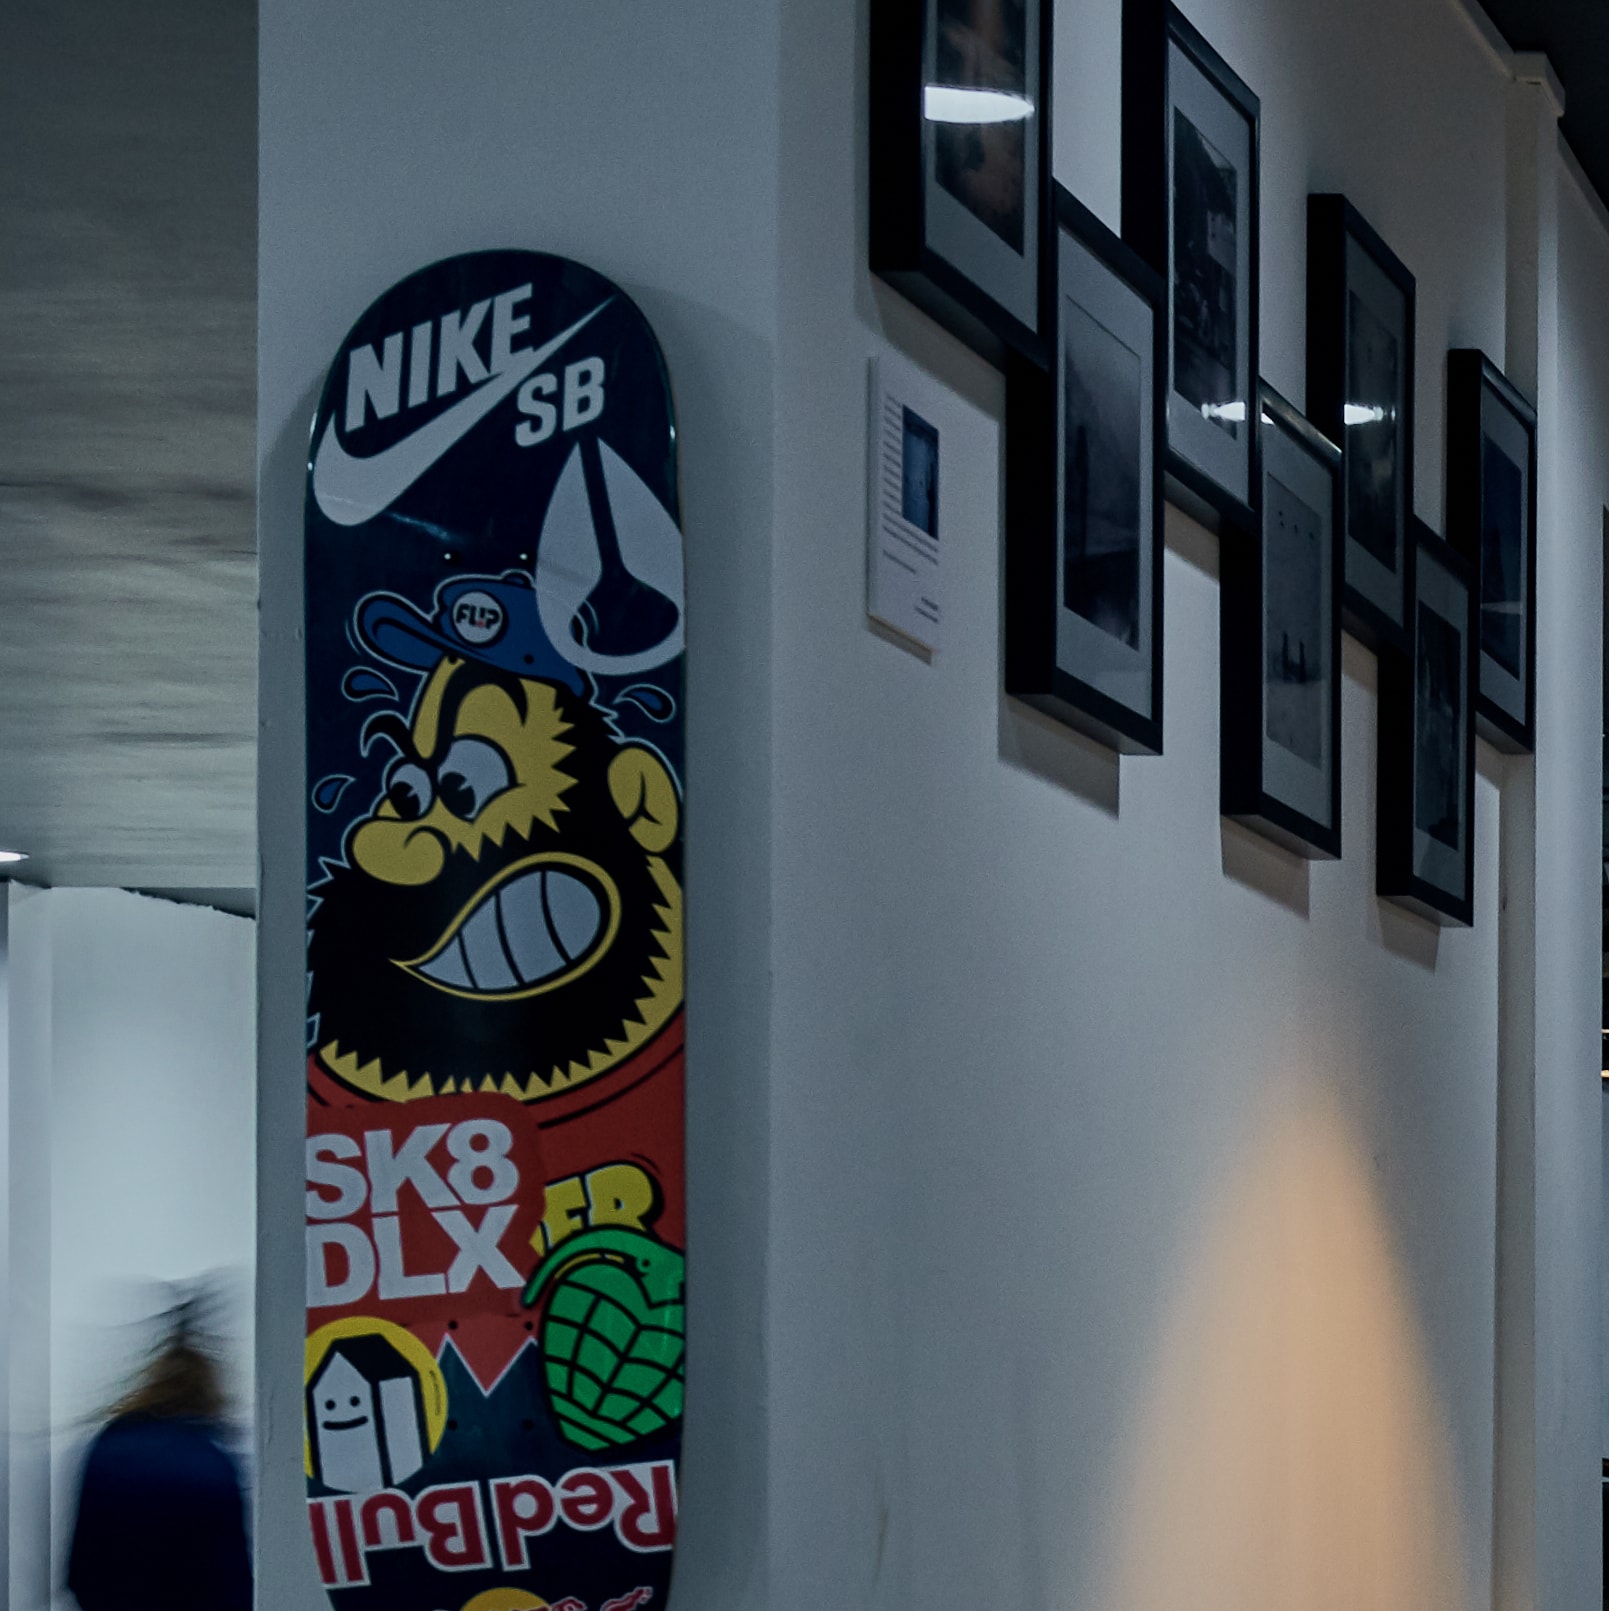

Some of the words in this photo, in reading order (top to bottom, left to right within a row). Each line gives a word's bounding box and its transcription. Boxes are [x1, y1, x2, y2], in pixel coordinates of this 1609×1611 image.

[345, 281, 534, 433] NIKE
[514, 356, 606, 448] SB
[306, 1117, 520, 1221] SK8
[306, 1203, 527, 1308] DLX
[307, 1480, 495, 1590] Bull
[490, 1461, 678, 1572] Red
